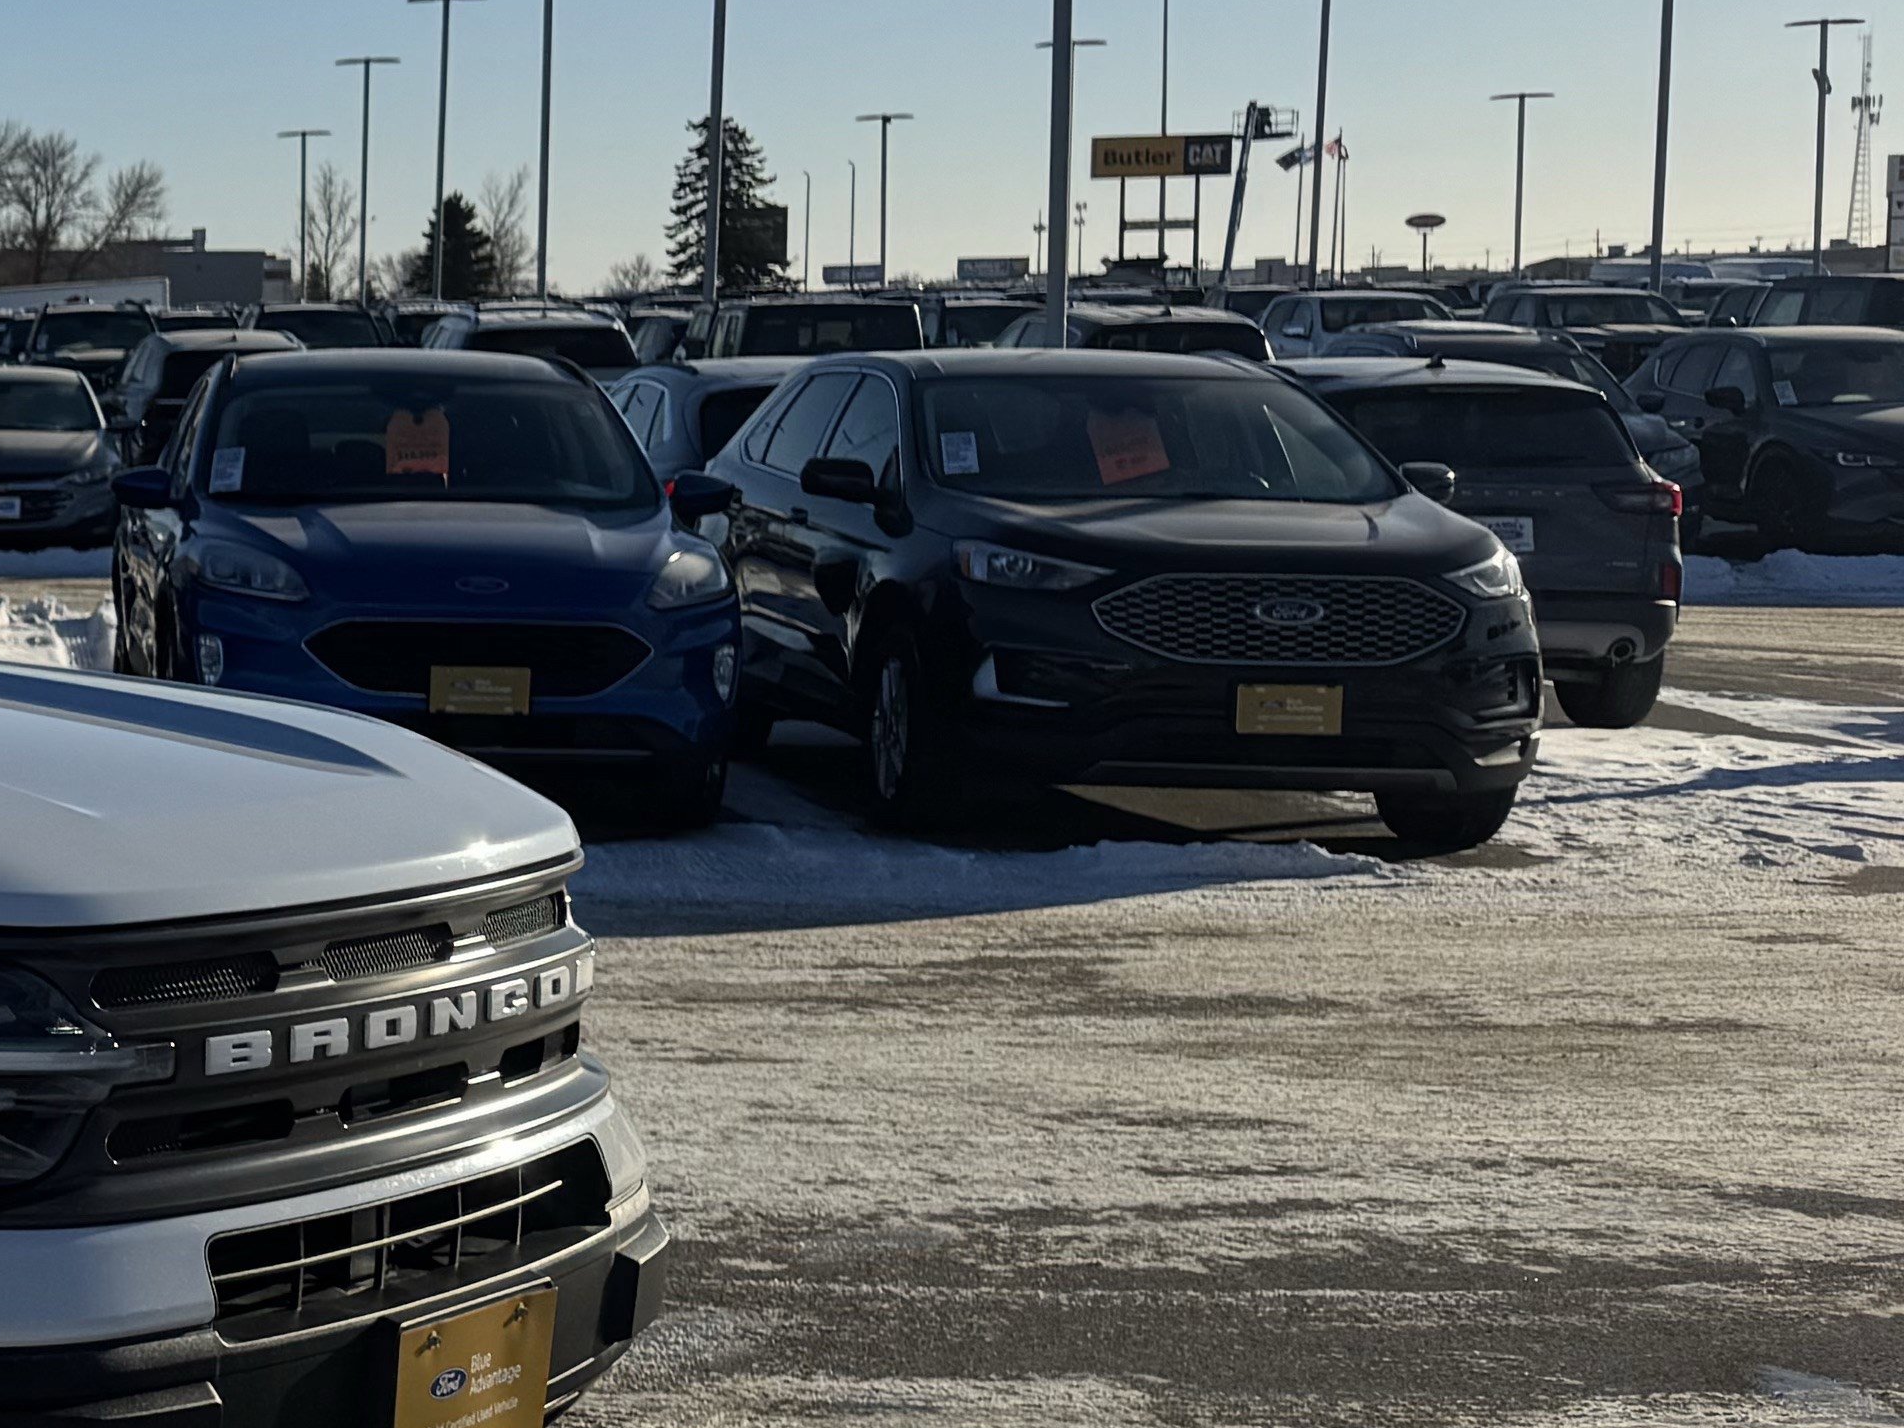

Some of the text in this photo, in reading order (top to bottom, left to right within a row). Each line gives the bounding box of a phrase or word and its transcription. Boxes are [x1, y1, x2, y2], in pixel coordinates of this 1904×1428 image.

[1103, 143, 1224, 166] Butler CAT
[205, 965, 570, 1075] BRONCO
[471, 1352, 492, 1374] Blue
[436, 1373, 461, 1396] Ford
[469, 1364, 522, 1396] Advantage
[477, 1406, 493, 1422] Used
[494, 1396, 518, 1414] Vehicle
